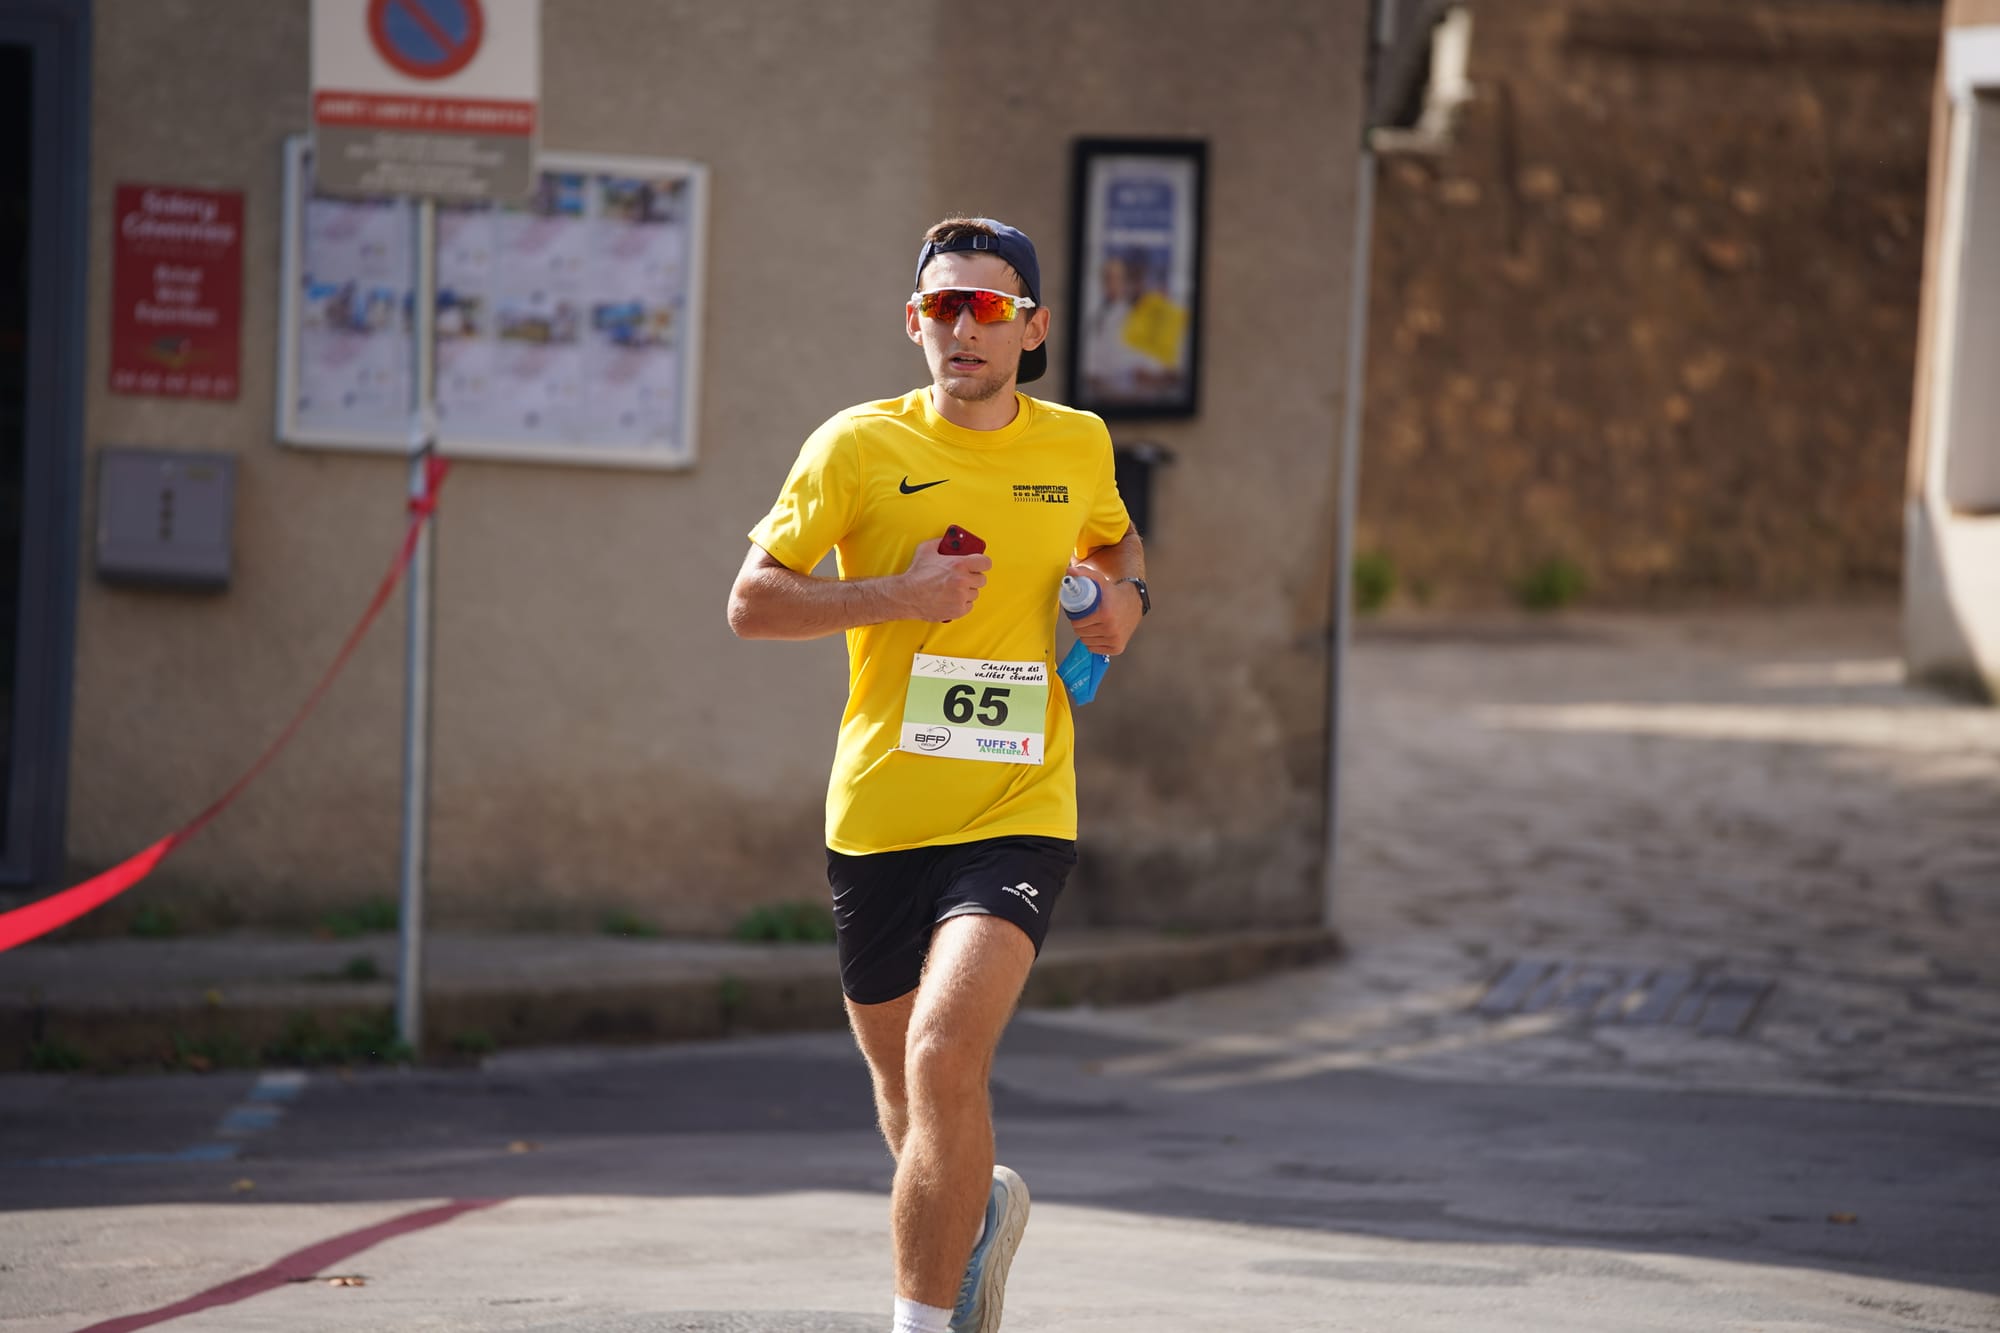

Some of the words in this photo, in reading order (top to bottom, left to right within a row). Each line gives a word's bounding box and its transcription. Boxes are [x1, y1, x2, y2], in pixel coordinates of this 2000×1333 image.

[981, 663, 1023, 675] Challenge
[1027, 665, 1039, 673] des
[974, 671, 1005, 680] vallées
[943, 684, 1011, 727] 65
[914, 733, 946, 744] BFP
[976, 738, 1018, 749] TUFF'S
[979, 746, 1021, 756] Aventure
